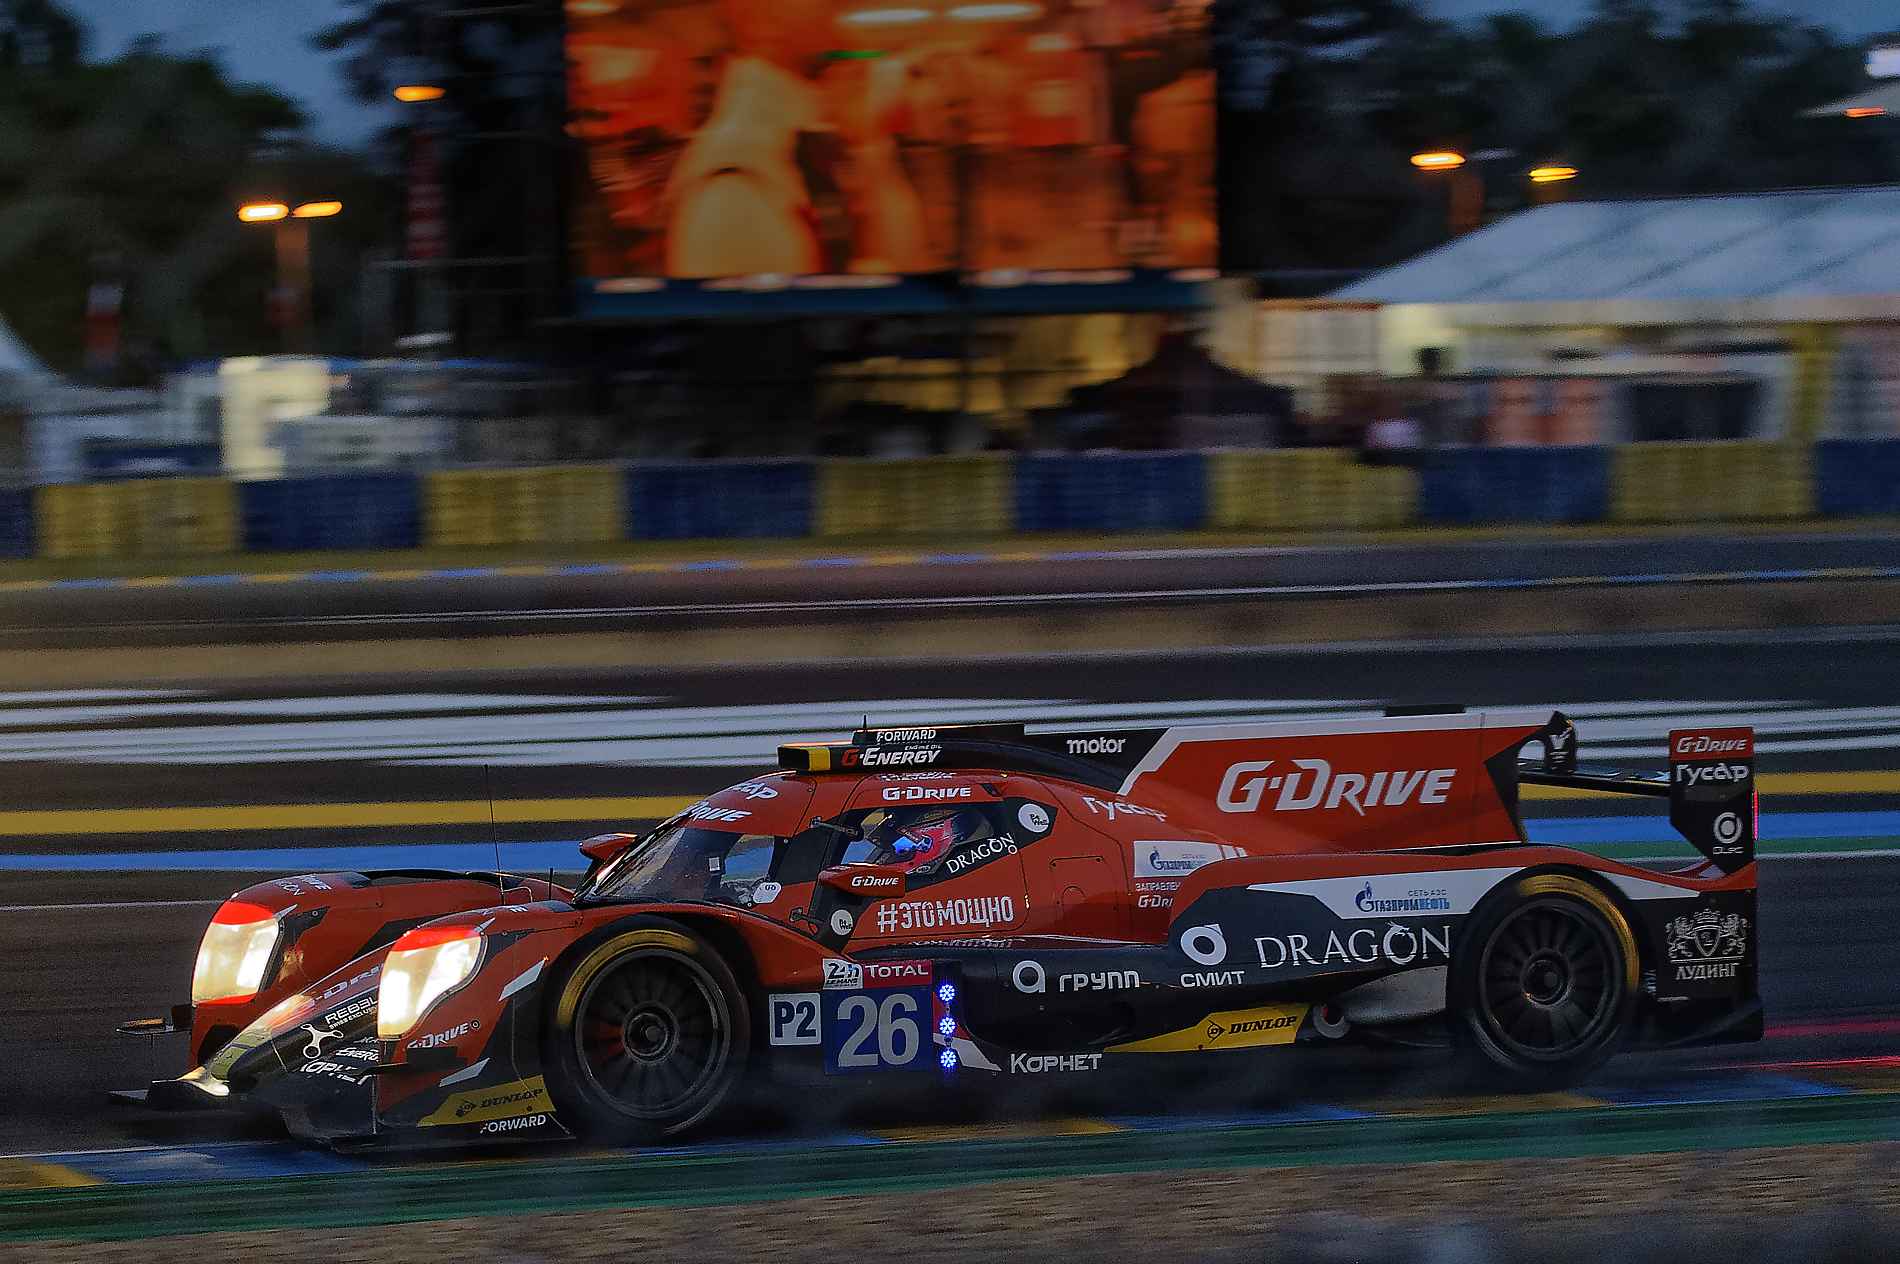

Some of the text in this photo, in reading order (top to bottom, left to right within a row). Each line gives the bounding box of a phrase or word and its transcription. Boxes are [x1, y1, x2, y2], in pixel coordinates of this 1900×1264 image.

[876, 730, 937, 743] FORWARD
[1066, 736, 1127, 754] motor
[877, 896, 1014, 933] #ЭТОМОЩНО
[1254, 921, 1452, 968] DRAGON
[865, 964, 929, 979] TOTAL
[1180, 970, 1245, 988] СМИТ
[773, 1000, 817, 1038] P2
[1228, 1016, 1297, 1034] DUNLOP
[837, 993, 920, 1067] 26
[1010, 1053, 1102, 1074] КОРНЕТ
